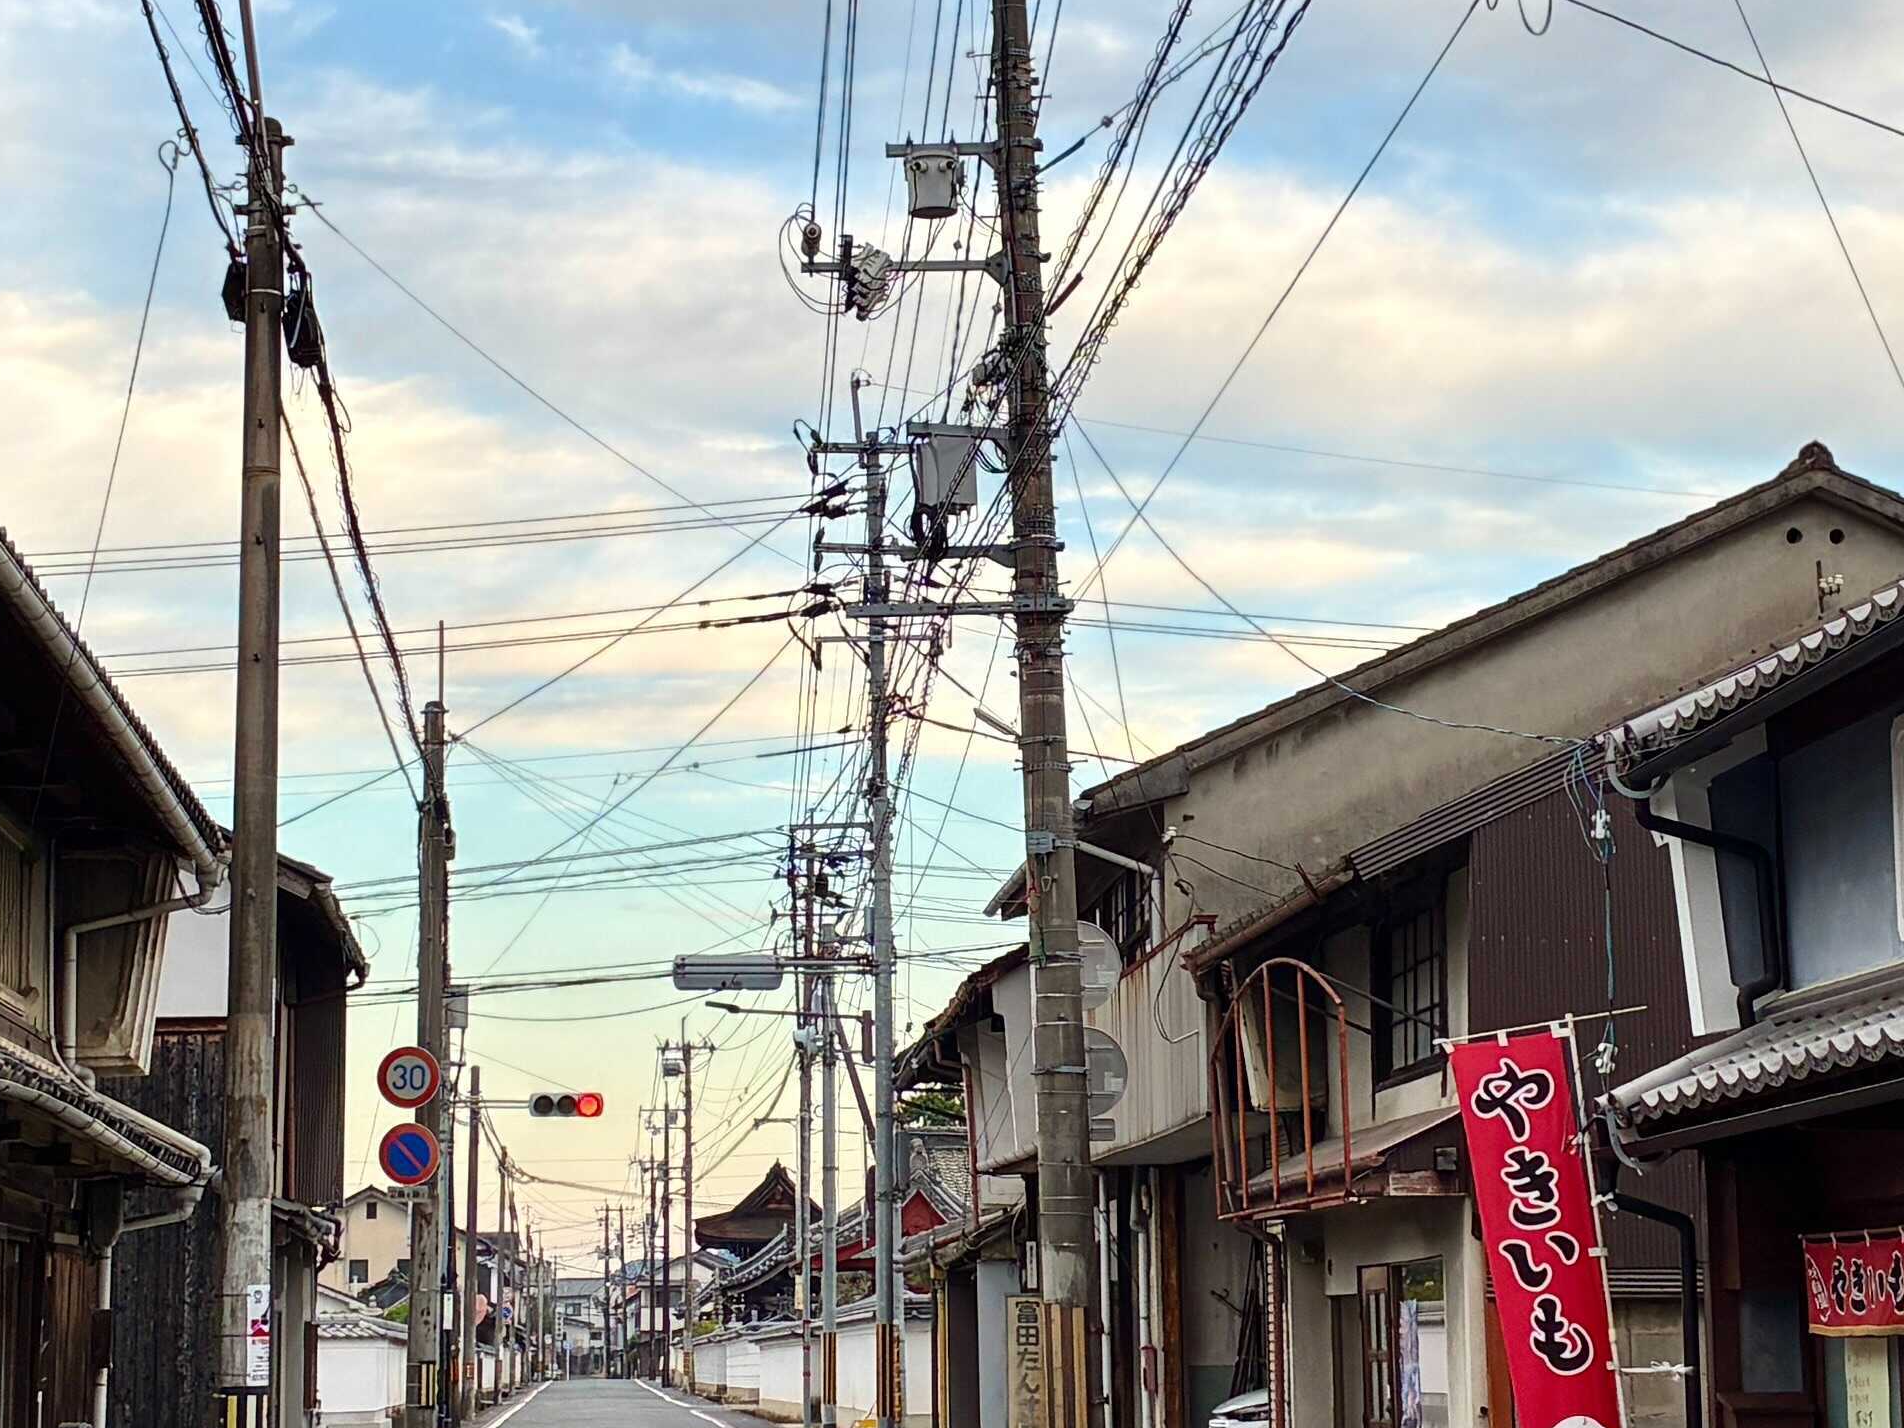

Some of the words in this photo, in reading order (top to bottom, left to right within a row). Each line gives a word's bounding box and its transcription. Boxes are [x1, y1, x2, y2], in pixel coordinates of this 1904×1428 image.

[392, 1064, 426, 1091] 30
[1471, 1058, 1594, 1376] やきいも
